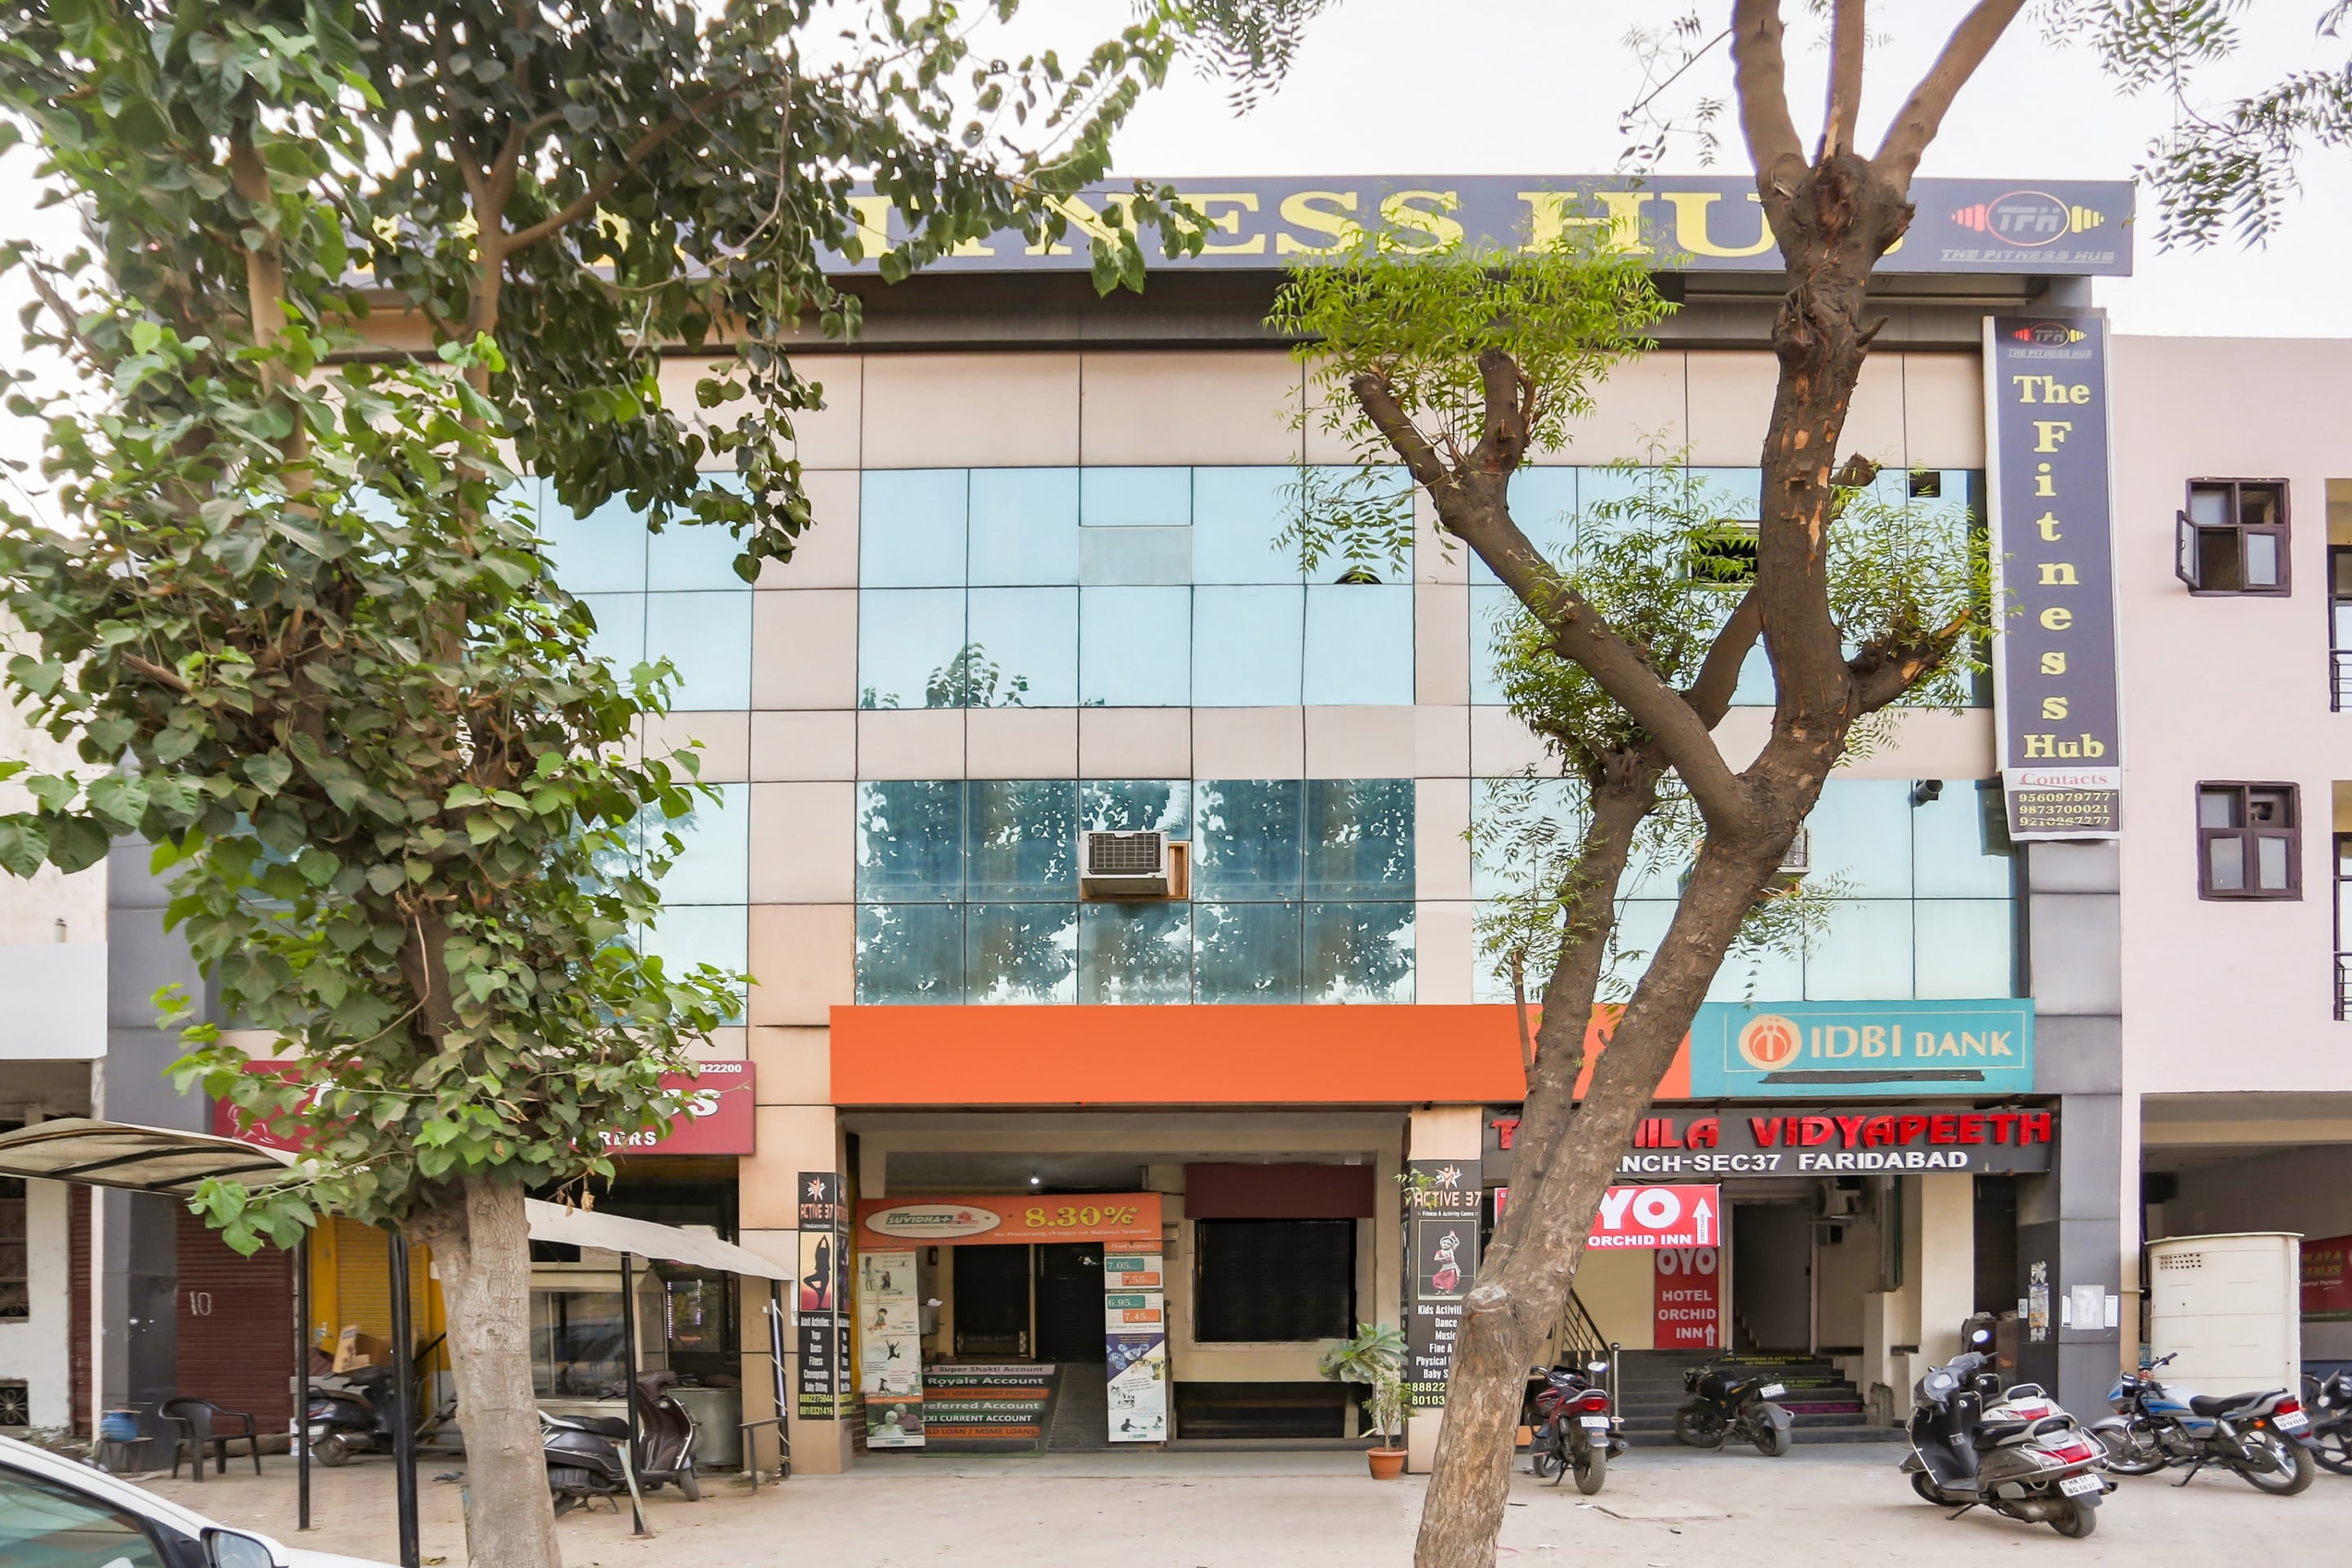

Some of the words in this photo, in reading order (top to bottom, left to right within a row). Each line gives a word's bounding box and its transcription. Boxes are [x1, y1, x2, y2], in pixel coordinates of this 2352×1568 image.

[1517, 190, 1904, 258] HU
[1940, 249, 1979, 261] THE
[1982, 250, 2069, 261] FITNESS
[2073, 252, 2115, 262] HUB
[2012, 375, 2091, 405] The
[2023, 733, 2105, 760] Hub
[2020, 772, 2108, 786] Contacts
[2018, 792, 2110, 803] 9560979777
[2018, 804, 2109, 814] 9873700021
[1811, 1024, 1902, 1058] IDBI
[1490, 1116, 1721, 1151] TILA
[1749, 1111, 2052, 1150] VIDYAPEETH
[1615, 1153, 1782, 1173] NCH-SEC37
[1797, 1151, 1969, 1172] FARIDABAD
[1465, 1191, 1483, 1207] 37
[1597, 1187, 1682, 1230] YO
[1588, 1235, 1655, 1247] ORCHID
[1660, 1234, 1692, 1245] INN
[1656, 1247, 1717, 1276] OYO
[1662, 1290, 1713, 1303] HOTEL
[1418, 1304, 1434, 1315] Kids
[1436, 1304, 1462, 1315] Activiti
[1658, 1308, 1717, 1321] ORCHID
[1435, 1317, 1458, 1328] Dance
[1676, 1327, 1703, 1339] INN
[1429, 1343, 1446, 1353] Fine
[1415, 1356, 1447, 1366] Physical
[1423, 1369, 1441, 1380] Baby
[928, 1377, 978, 1386] Royale
[1412, 1382, 1446, 1392] 88822
[923, 1402, 979, 1410] referred
[1412, 1395, 1446, 1405] 80103
